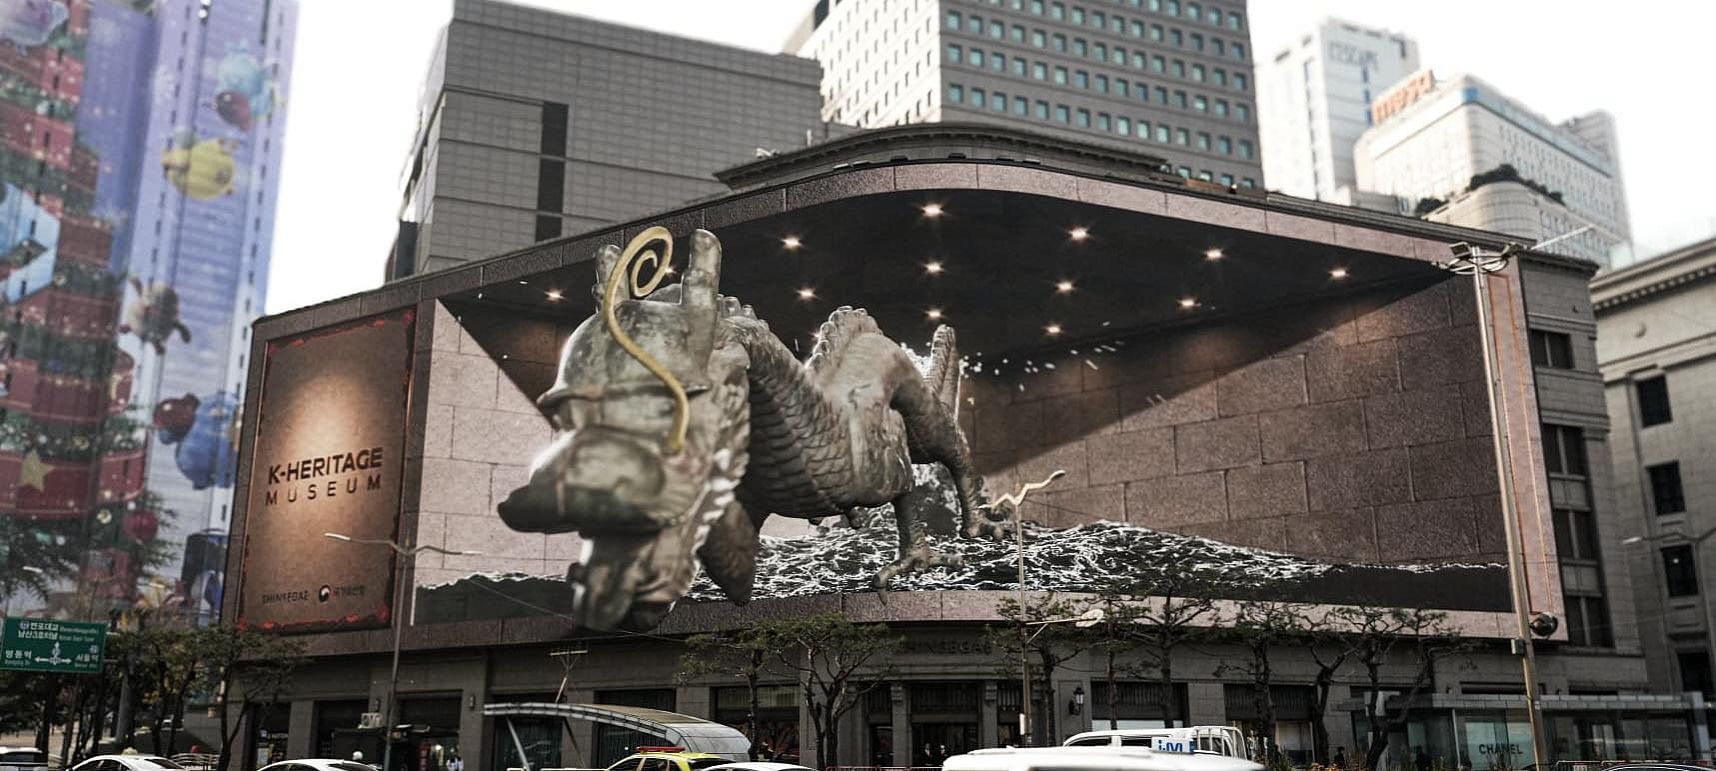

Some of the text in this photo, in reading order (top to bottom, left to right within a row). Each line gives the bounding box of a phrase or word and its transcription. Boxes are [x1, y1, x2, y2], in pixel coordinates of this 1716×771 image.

[268, 447, 383, 485] K-HERITAGE
[265, 474, 381, 506] MUSEUM
[1479, 743, 1523, 755] CHANEL
